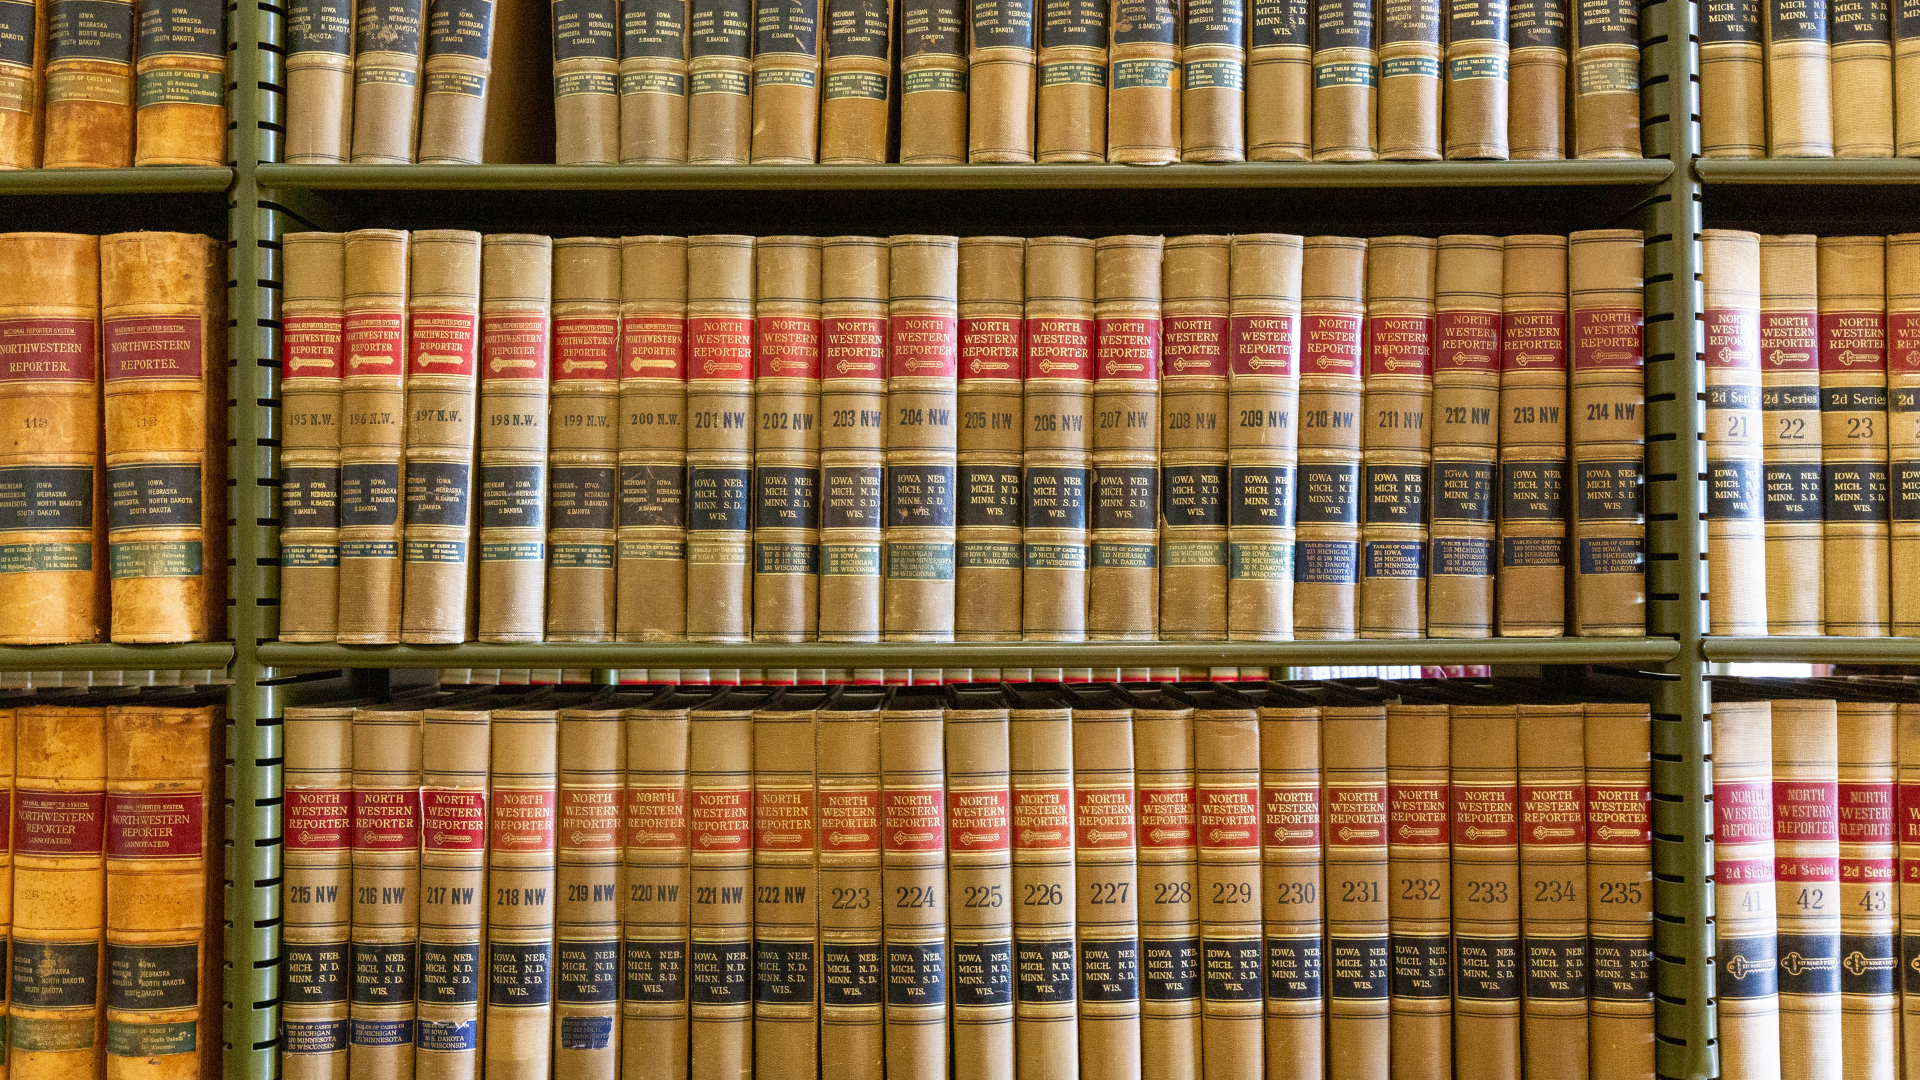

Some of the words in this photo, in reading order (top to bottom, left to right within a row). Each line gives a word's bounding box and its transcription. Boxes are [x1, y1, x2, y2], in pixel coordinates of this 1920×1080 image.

[1256, 7, 1282, 15] MICH.
[1709, 4, 1735, 12] MICH.
[1835, 4, 1863, 12] MICH.
[321, 16, 350, 24] NEBRASKA
[1256, 18, 1282, 26] MINN.
[1709, 14, 1736, 22] MINN.
[1174, 320, 1212, 330] NORTH
[1514, 316, 1553, 325] NORTH
[1769, 317, 1808, 326] NORTH
[971, 322, 1010, 332] NORTH
[412, 330, 470, 340] NORTHWESTERN
[1506, 328, 1560, 338] WESTERN
[1762, 327, 1815, 338] WESTERN
[964, 334, 1017, 344] WESTERN
[1166, 333, 1218, 343] WESTERN
[1761, 337, 1817, 348] REPORTER
[111, 341, 191, 352] NORTHWESTERN
[420, 342, 463, 352] REPORTER
[1504, 340, 1562, 350] REPORTER
[962, 346, 1018, 357] REPORTER
[1164, 345, 1220, 356] REPORTER
[121, 359, 179, 370] REPORTER.
[1763, 392, 1779, 404] 2d
[1784, 393, 1817, 404] Series
[1514, 407, 1534, 424] 213
[1540, 407, 1559, 424] NW
[1587, 404, 1609, 420] 214
[1615, 403, 1635, 420] NW
[491, 415, 509, 426] 198
[512, 415, 538, 426] N.W.
[632, 414, 653, 426] 200
[658, 414, 680, 426] N.W.
[695, 412, 718, 429] 201
[723, 412, 744, 428] NW
[965, 412, 986, 429] 205
[991, 413, 1012, 430] NW
[1240, 410, 1263, 427] 209
[1268, 411, 1288, 428] NW
[1779, 418, 1805, 440] 22
[1847, 417, 1874, 439] 23
[1172, 476, 1194, 484] IOWA
[1201, 475, 1219, 484] NEB.
[1768, 472, 1792, 481] IOWA
[1801, 472, 1820, 480] NEB.
[1172, 486, 1196, 494] MICH.
[1202, 485, 1210, 494] N.
[1212, 486, 1219, 494] D.
[1768, 483, 1794, 491] MICH.
[1801, 483, 1809, 491] N.
[1811, 483, 1819, 491] D.
[1172, 497, 1196, 506] MINN.
[1201, 496, 1208, 505] S.
[1211, 496, 1218, 505] D.
[1768, 493, 1795, 501] MINN.
[1802, 493, 1809, 501] S.
[1810, 493, 1818, 501] D.
[1187, 507, 1205, 516] WIS.
[1785, 504, 1804, 512] WIS.
[1112, 552, 1146, 560] NEBRASKA
[984, 558, 1010, 566] DAKOTA
[299, 794, 340, 804] NORTH
[1209, 794, 1248, 804] NORTH
[1597, 790, 1639, 800] NORTH
[1788, 789, 1826, 801] NORTH
[829, 796, 868, 806] NORTH
[292, 806, 348, 816] WESTERN
[822, 807, 875, 817] WESTERN
[1202, 804, 1254, 814] WESTERN
[1590, 802, 1646, 812] WESTERN
[1778, 805, 1833, 818] WESTERN
[112, 814, 190, 825] NORTHWESTERN
[1202, 815, 1256, 825] REPORTER
[1589, 812, 1648, 823] REPORTER
[289, 818, 350, 828] REPORTER
[822, 818, 877, 828] REPORTER
[1778, 822, 1836, 834] REPORTER
[122, 828, 173, 837] REPORTER
[1843, 866, 1859, 878] 2d
[1864, 866, 1896, 878] Series
[290, 886, 310, 904] 215
[315, 886, 338, 903] NW
[427, 887, 446, 904] 217
[451, 887, 474, 905] NW
[697, 887, 717, 904] 221
[722, 886, 743, 904] NW
[1090, 882, 1130, 904] 227
[1341, 881, 1381, 902] 231
[1468, 881, 1508, 903] 233
[1600, 882, 1642, 904] 235
[832, 888, 870, 910] 223
[1796, 888, 1824, 910] 42
[1462, 948, 1487, 956] IOWA
[1496, 948, 1516, 956] NEB.
[357, 954, 378, 962] IOWA
[385, 953, 406, 962] NEB.
[1462, 958, 1490, 967] MICH.
[357, 964, 378, 973] MICH.
[1463, 969, 1490, 978] MINN.
[357, 975, 379, 984] MINN.
[370, 986, 388, 995] WIS.
[1480, 981, 1500, 990] WIS.
[297, 1029, 330, 1037] MICHIGAN
[297, 1036, 336, 1044] MINNESOTA
